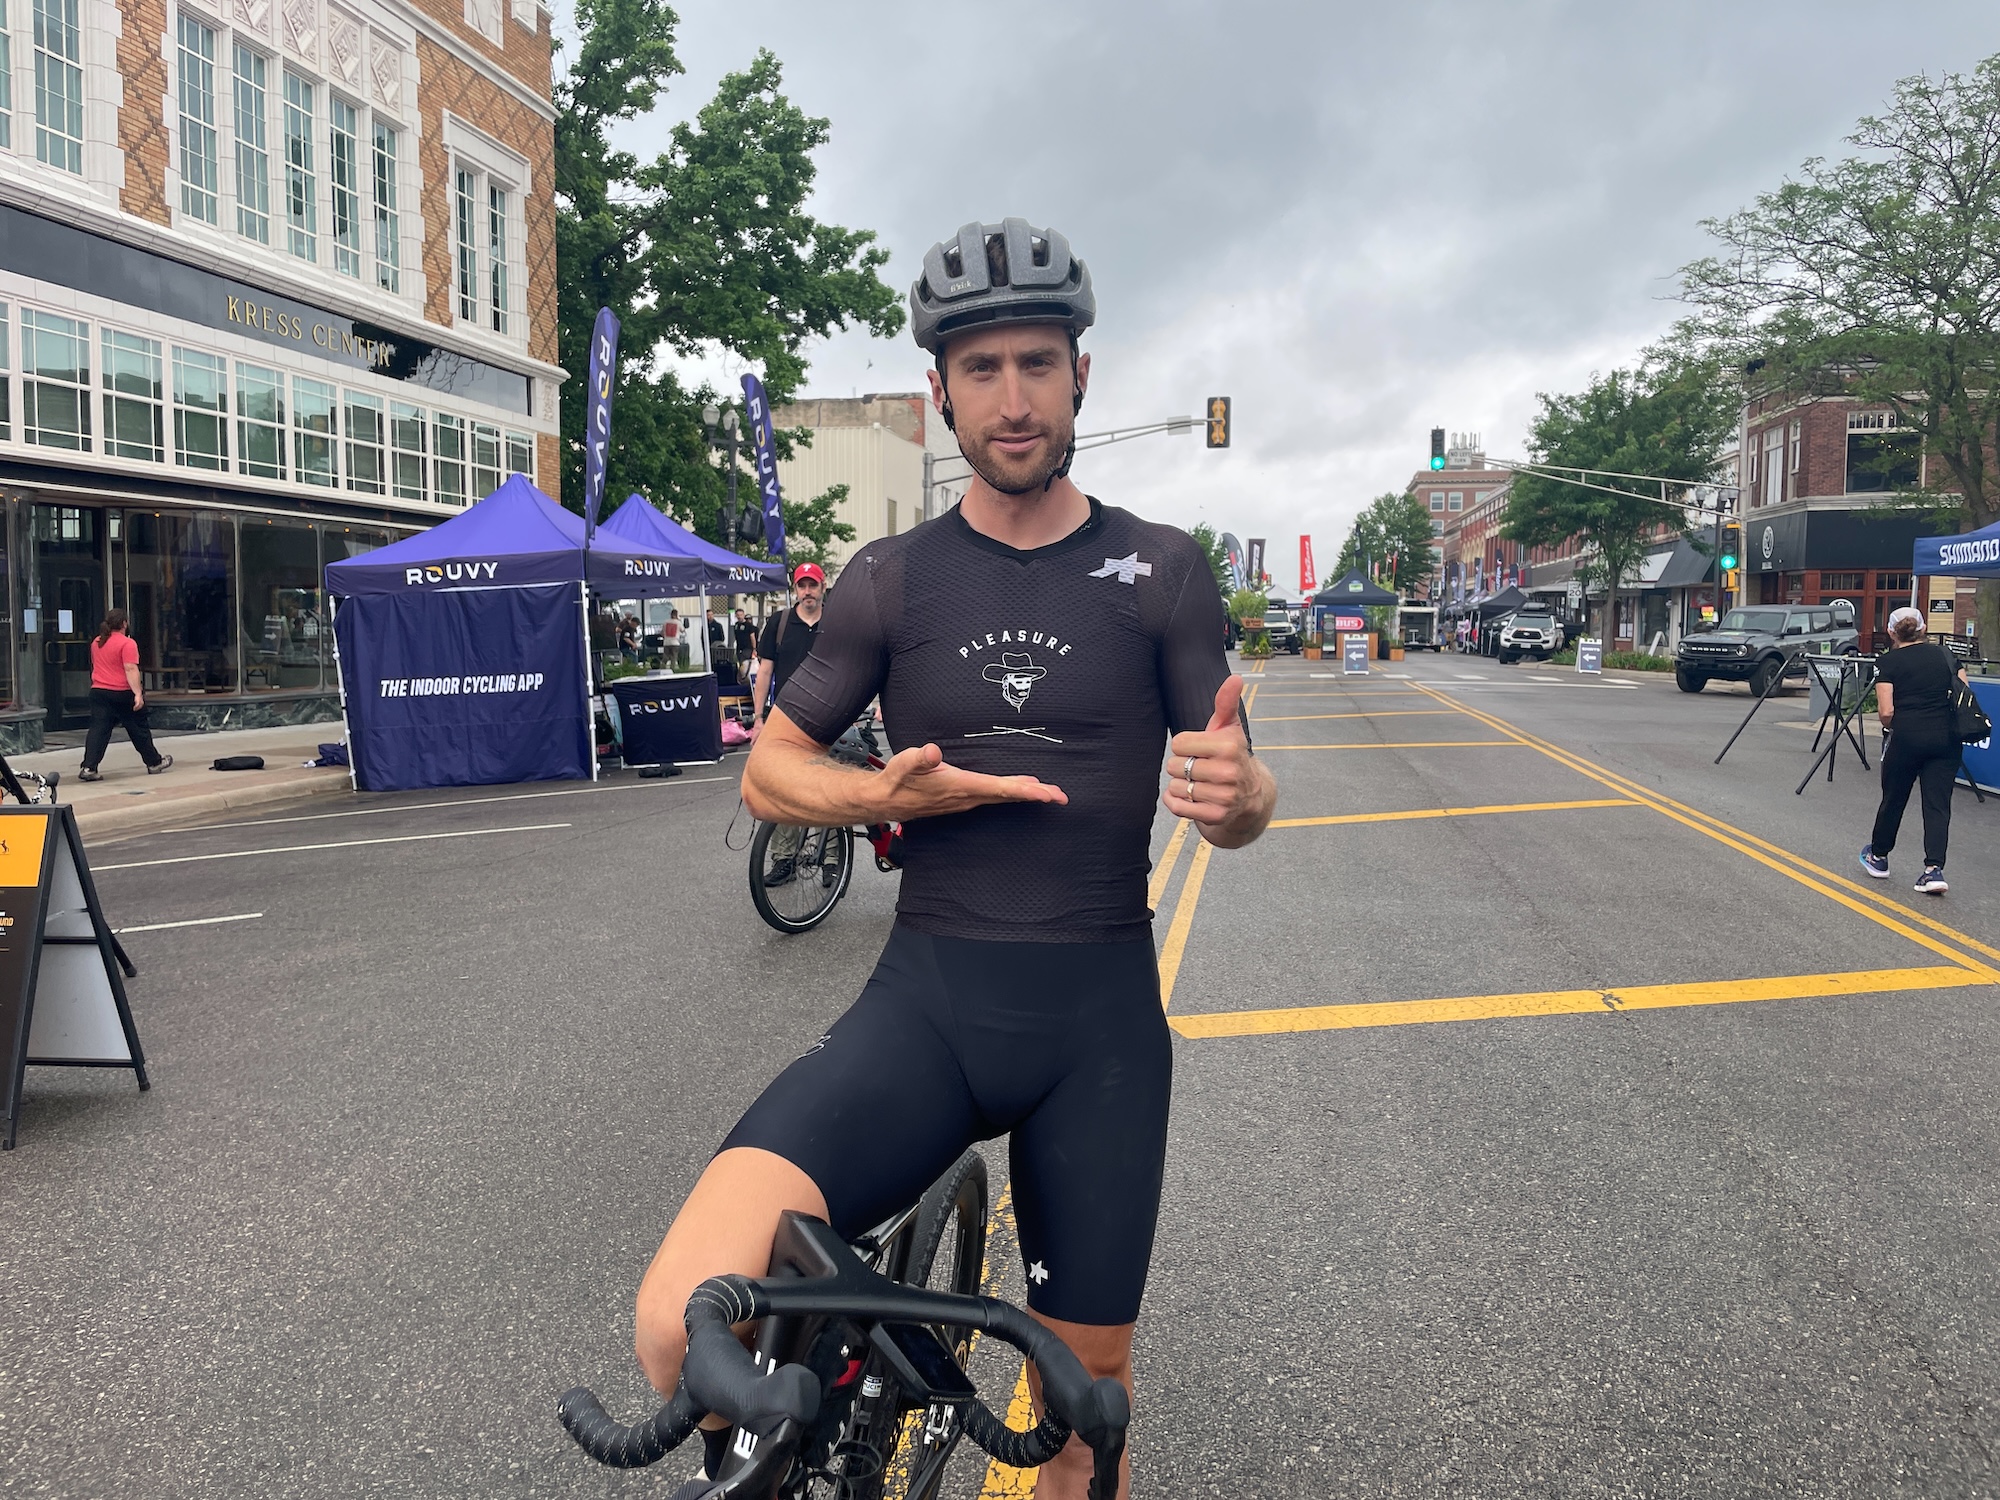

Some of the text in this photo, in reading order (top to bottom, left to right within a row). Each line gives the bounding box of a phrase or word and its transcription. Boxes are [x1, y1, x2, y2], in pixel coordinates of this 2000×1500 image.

[226, 294, 390, 367] KRESS CENTER
[593, 334, 610, 496] ROUVY
[750, 397, 780, 519] ROUVY
[1939, 538, 2000, 566] SHIMANO
[405, 562, 498, 585] ROUVY
[625, 560, 670, 577] ROUVY
[728, 567, 763, 582] ROUVY
[959, 630, 1072, 658] PLEASURE
[381, 673, 544, 697] THE INDOOR CYCLING APP
[629, 695, 702, 715] ROUVY
